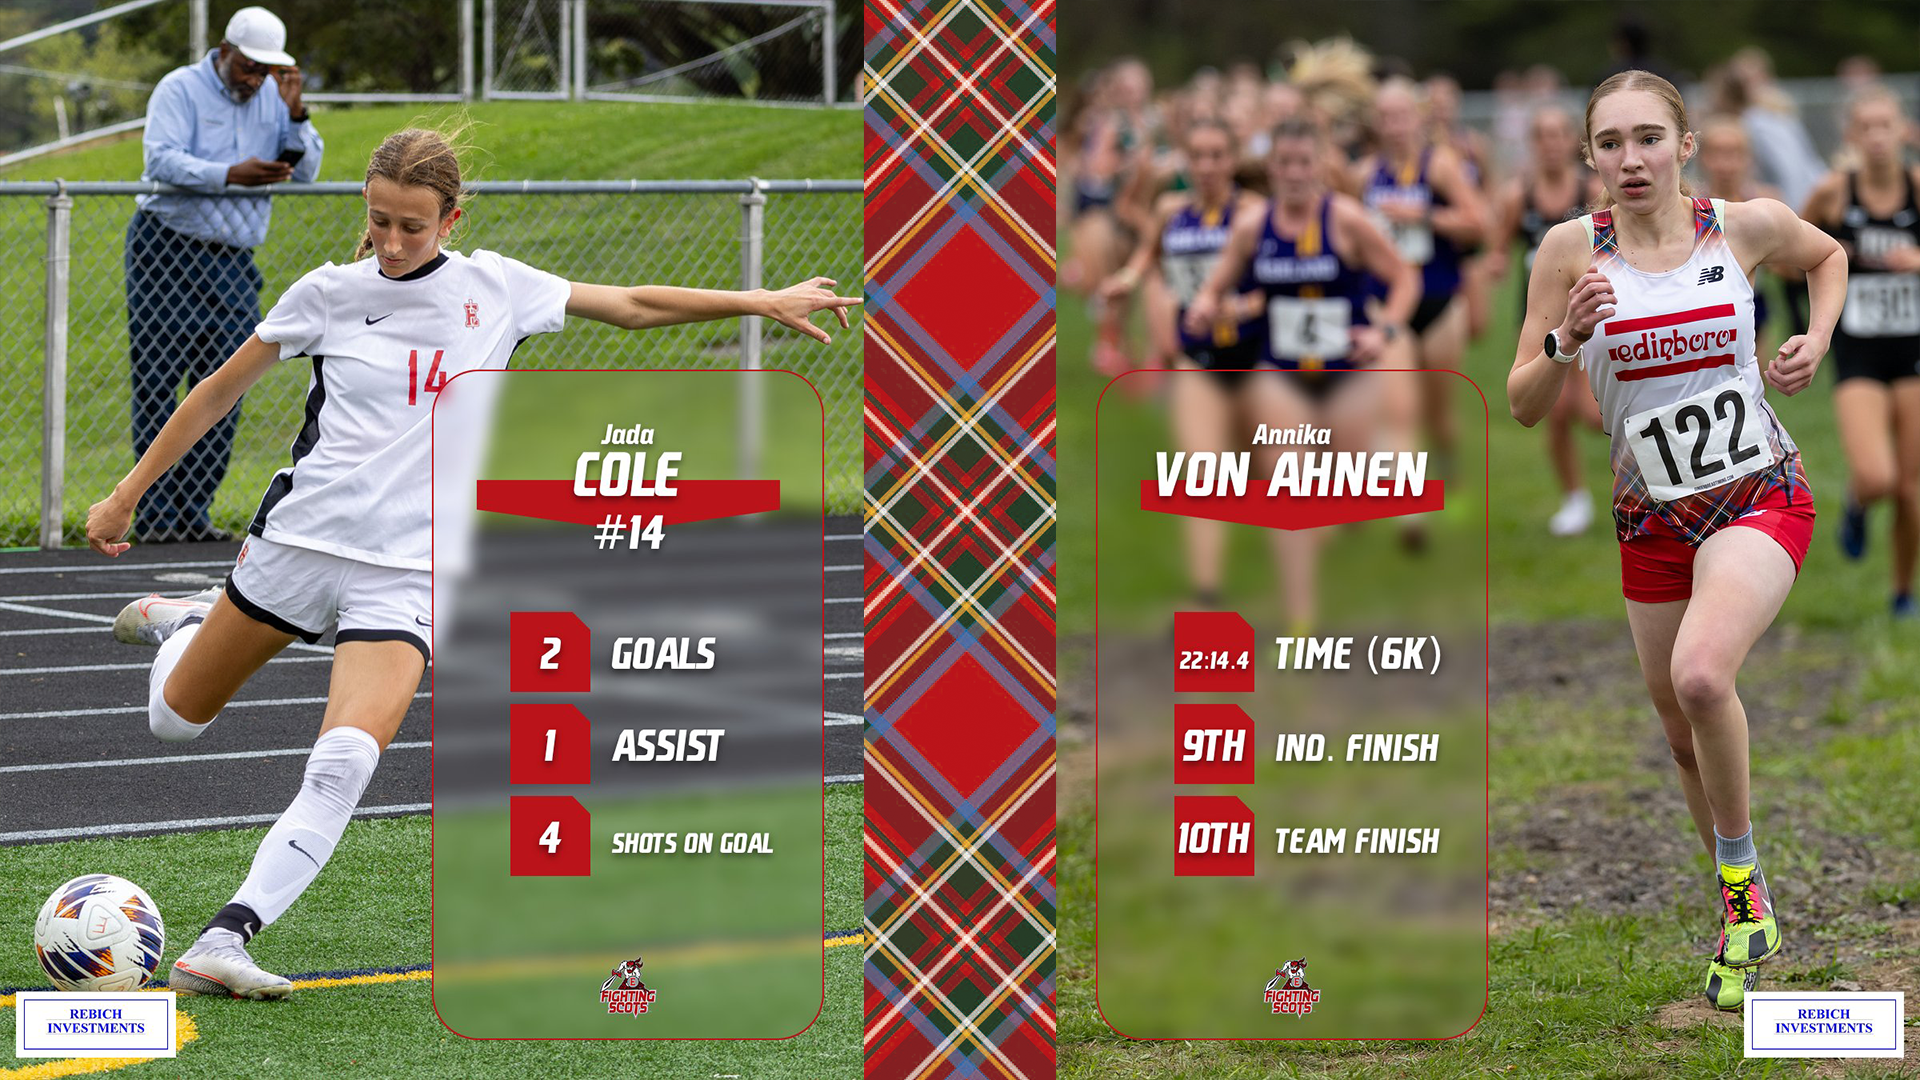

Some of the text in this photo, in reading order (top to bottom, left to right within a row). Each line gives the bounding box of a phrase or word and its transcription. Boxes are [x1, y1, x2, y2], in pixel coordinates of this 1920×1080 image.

[1617, 328, 1730, 363] edinboro
[407, 349, 447, 406] 14
[1640, 388, 1761, 486] 122
